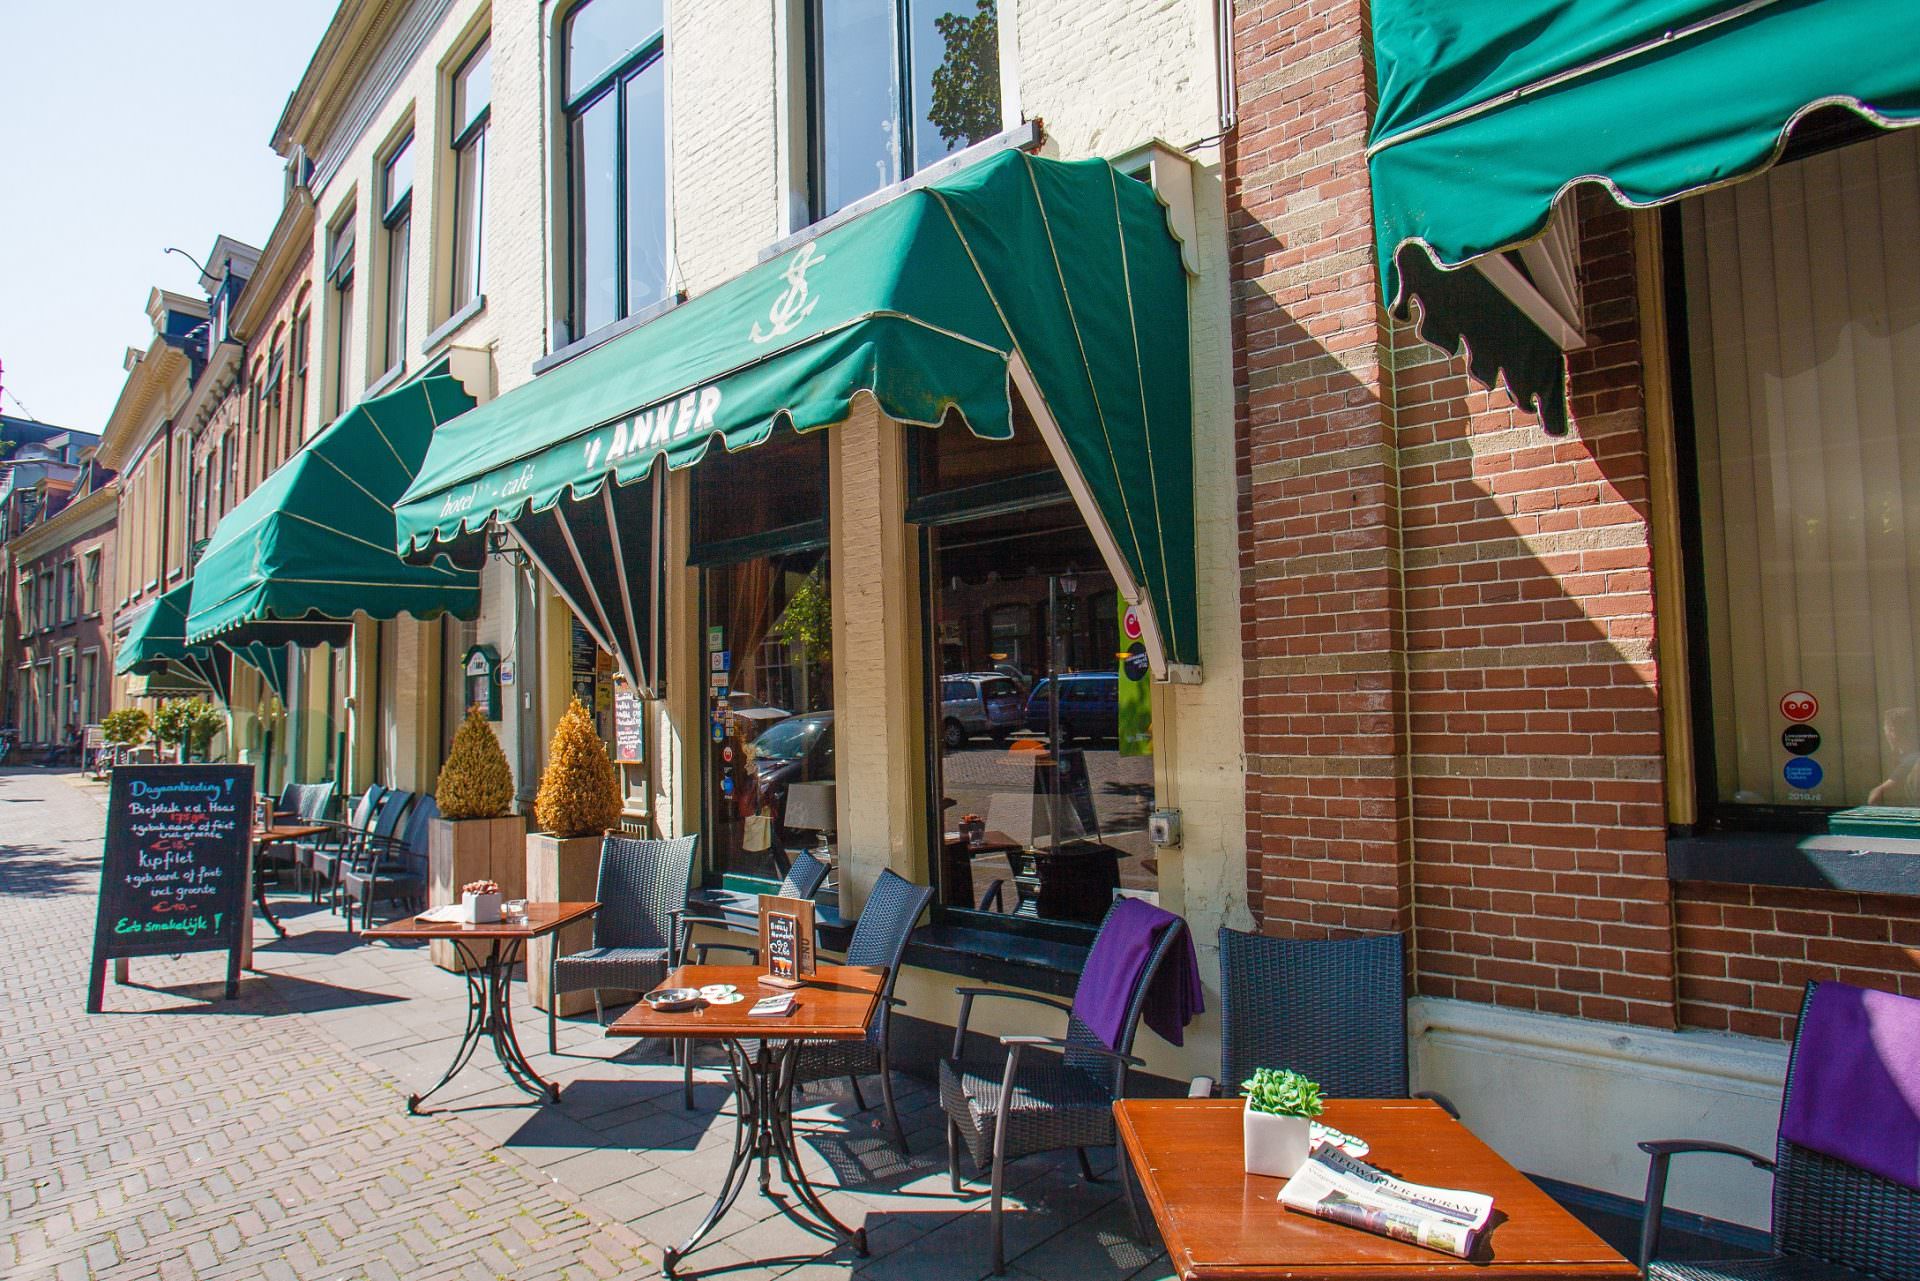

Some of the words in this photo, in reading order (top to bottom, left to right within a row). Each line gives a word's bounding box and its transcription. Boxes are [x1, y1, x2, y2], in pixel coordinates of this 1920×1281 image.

[604, 386, 722, 467] ANKER
[440, 482, 477, 517] hotel
[501, 463, 536, 498] café
[1412, 1191, 1481, 1215] COURANT
